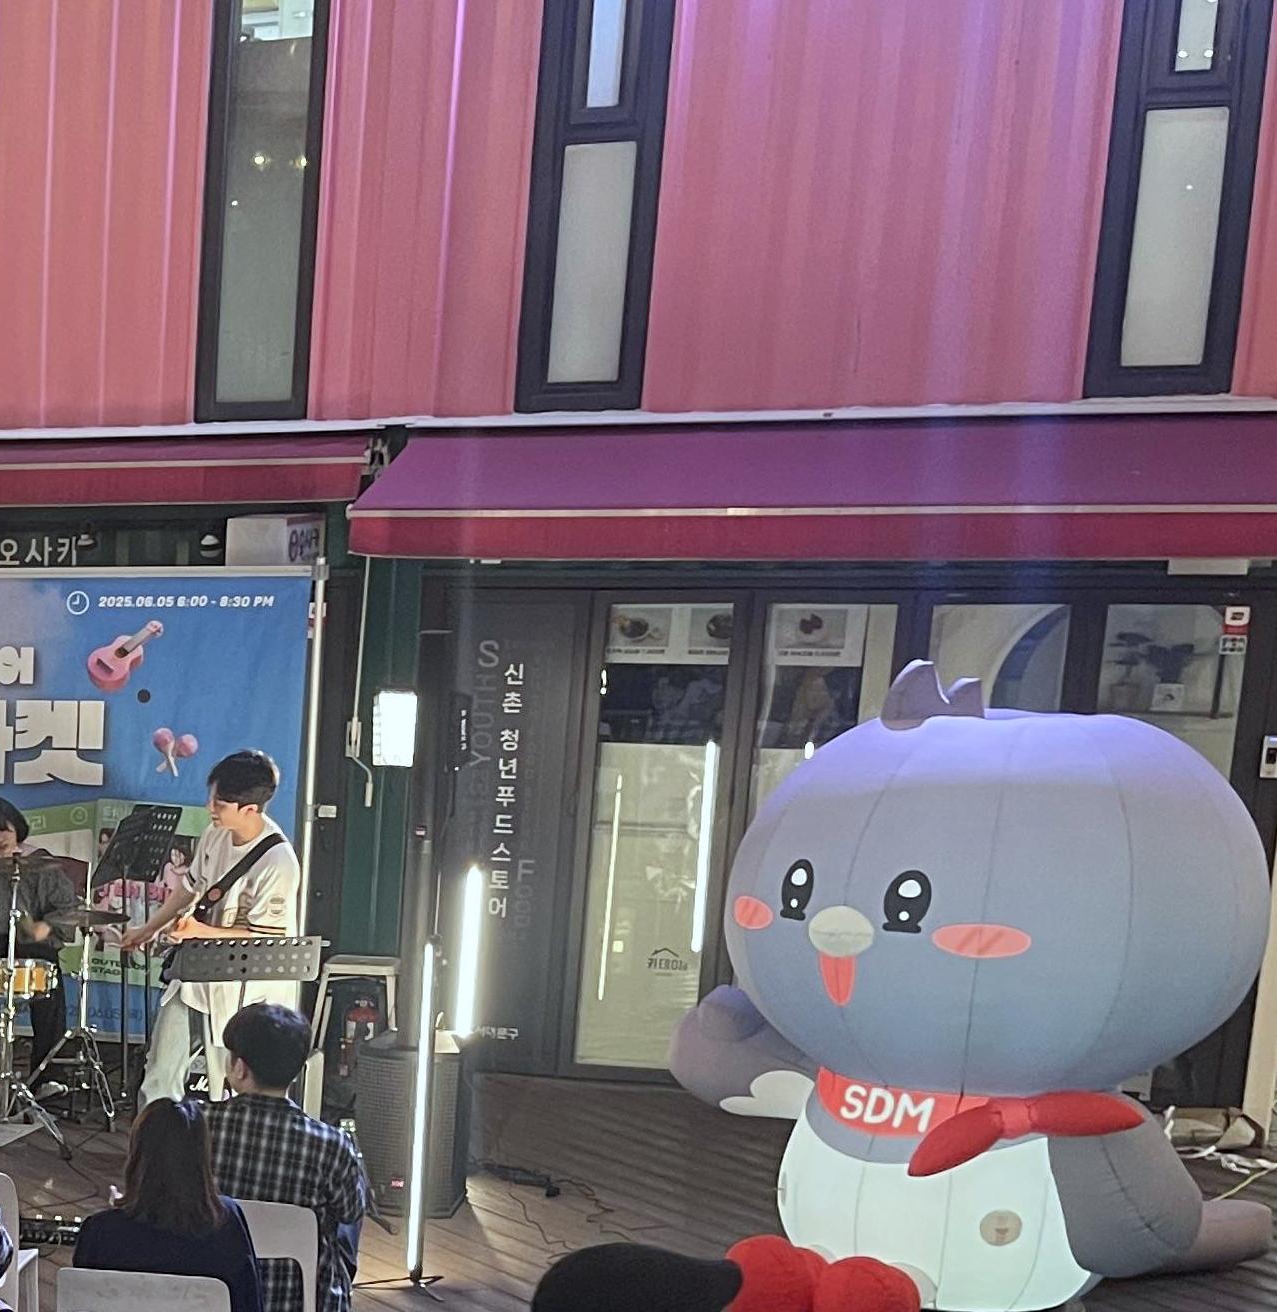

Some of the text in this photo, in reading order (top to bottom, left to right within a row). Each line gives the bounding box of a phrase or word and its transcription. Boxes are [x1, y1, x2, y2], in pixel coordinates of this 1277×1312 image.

[252, 595, 275, 607] PM
[488, 663, 525, 919] 신촌 청년푸드스토어
[839, 1084, 936, 1133] SDM
